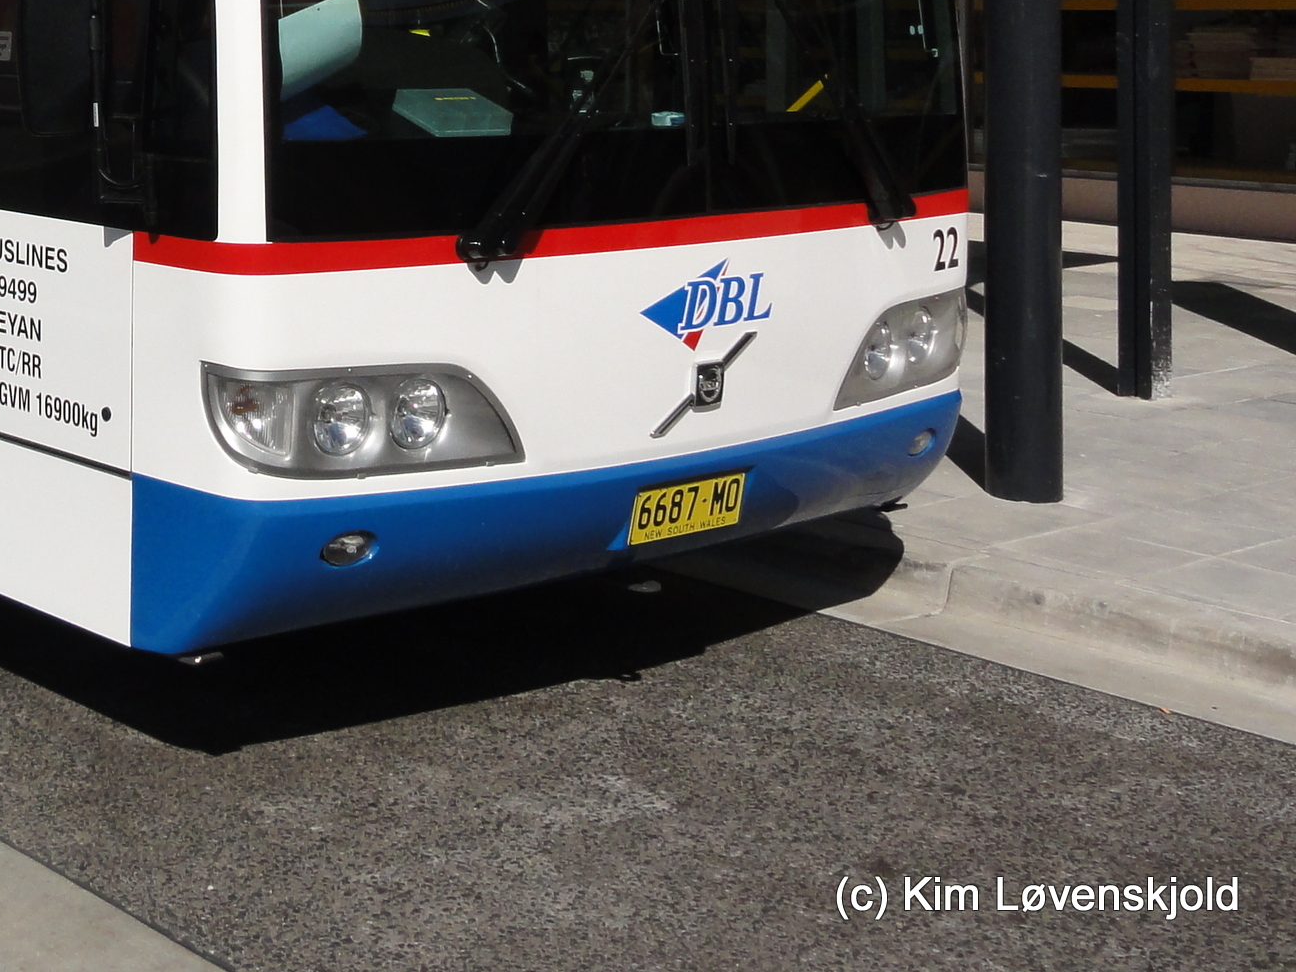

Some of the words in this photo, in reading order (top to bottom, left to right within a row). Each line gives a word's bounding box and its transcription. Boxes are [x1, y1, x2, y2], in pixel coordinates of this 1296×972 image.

[933, 227, 959, 271] 22
[679, 273, 772, 331] DBL
[0, 381, 30, 413] GVM
[36, 392, 98, 437] 16900kg
[644, 529, 663, 540] NEW
[667, 524, 695, 535] SOUTH
[700, 516, 726, 528] WALES
